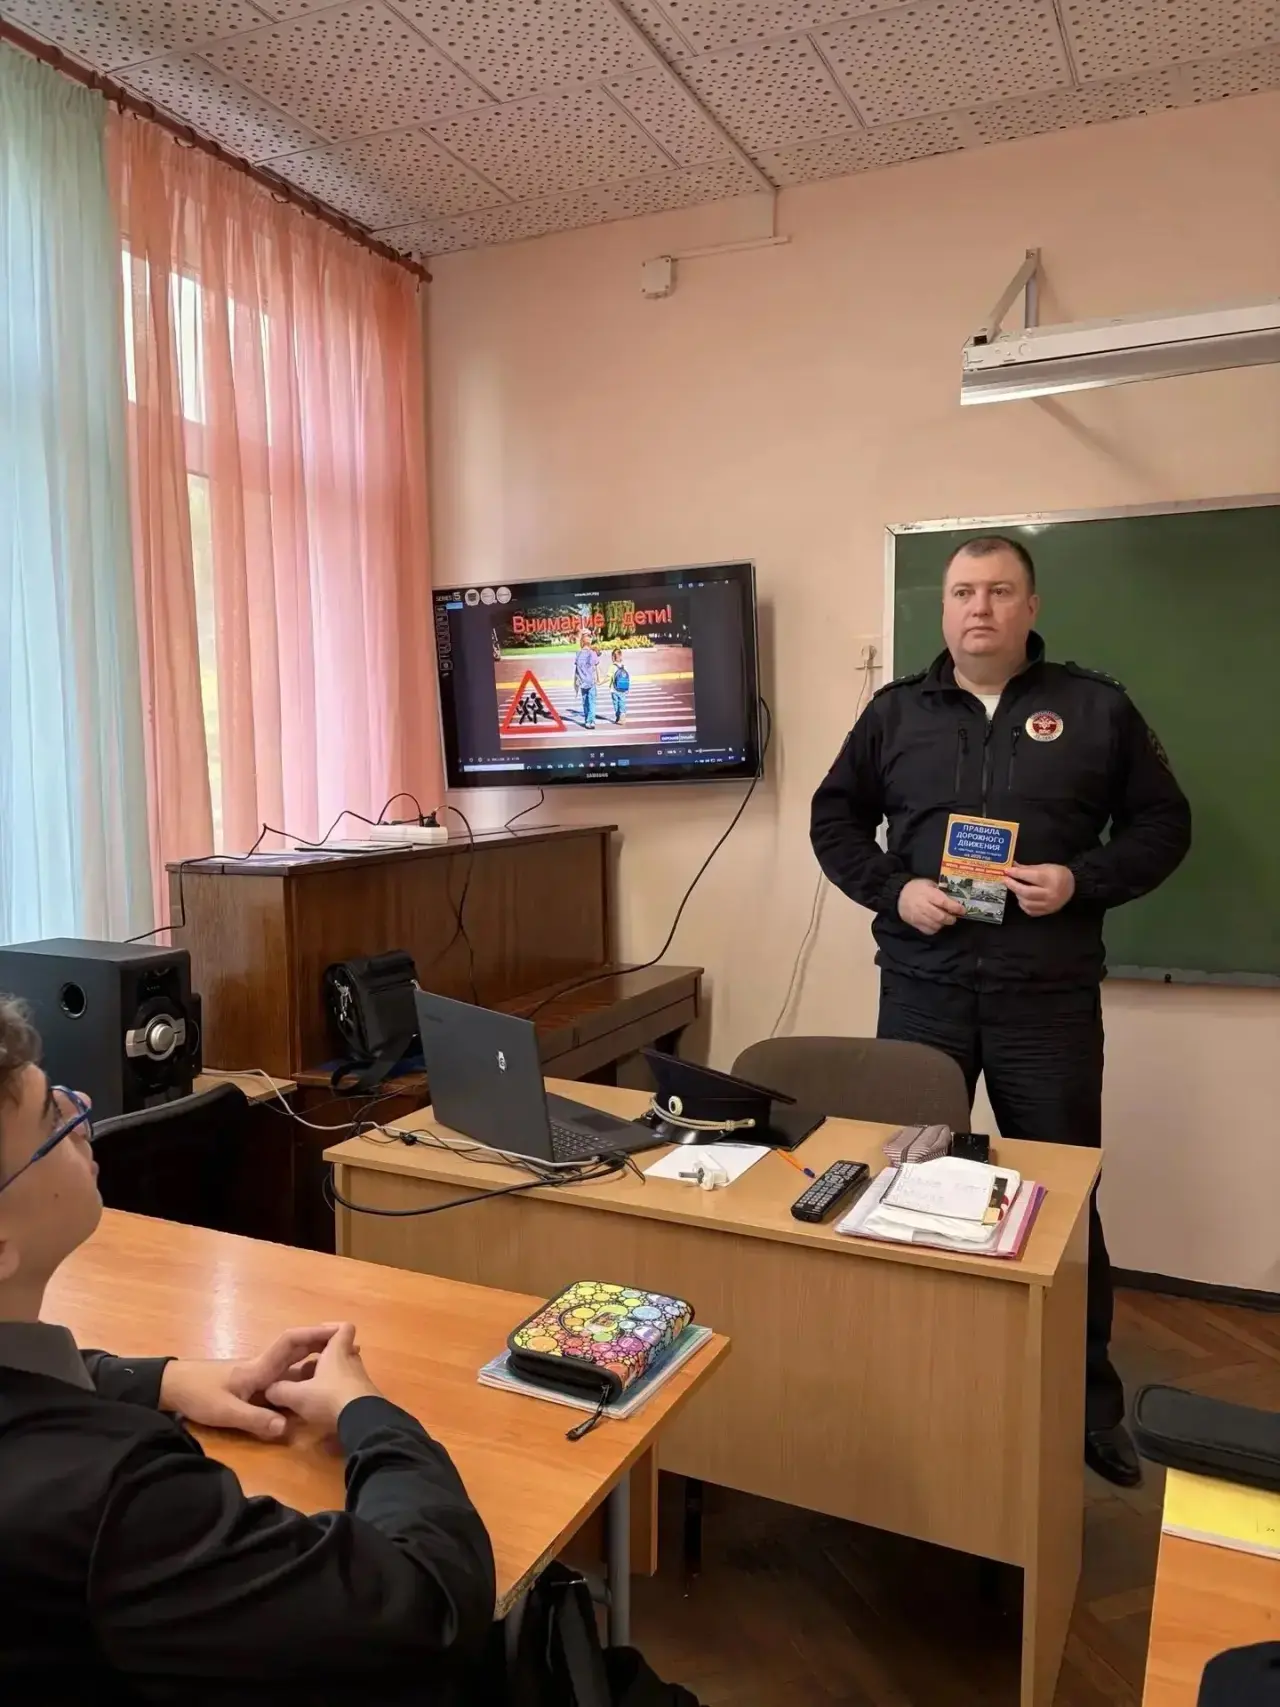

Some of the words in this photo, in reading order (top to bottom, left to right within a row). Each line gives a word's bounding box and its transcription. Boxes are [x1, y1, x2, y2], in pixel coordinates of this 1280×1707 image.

[512, 612, 606, 634] Внимание
[622, 604, 673, 627] дети!
[963, 824, 1000, 836] ПРАВИЛА
[956, 831, 1005, 843] ДОРОЖНОГО
[957, 839, 1001, 851] ДВИЖЕНИЯ
